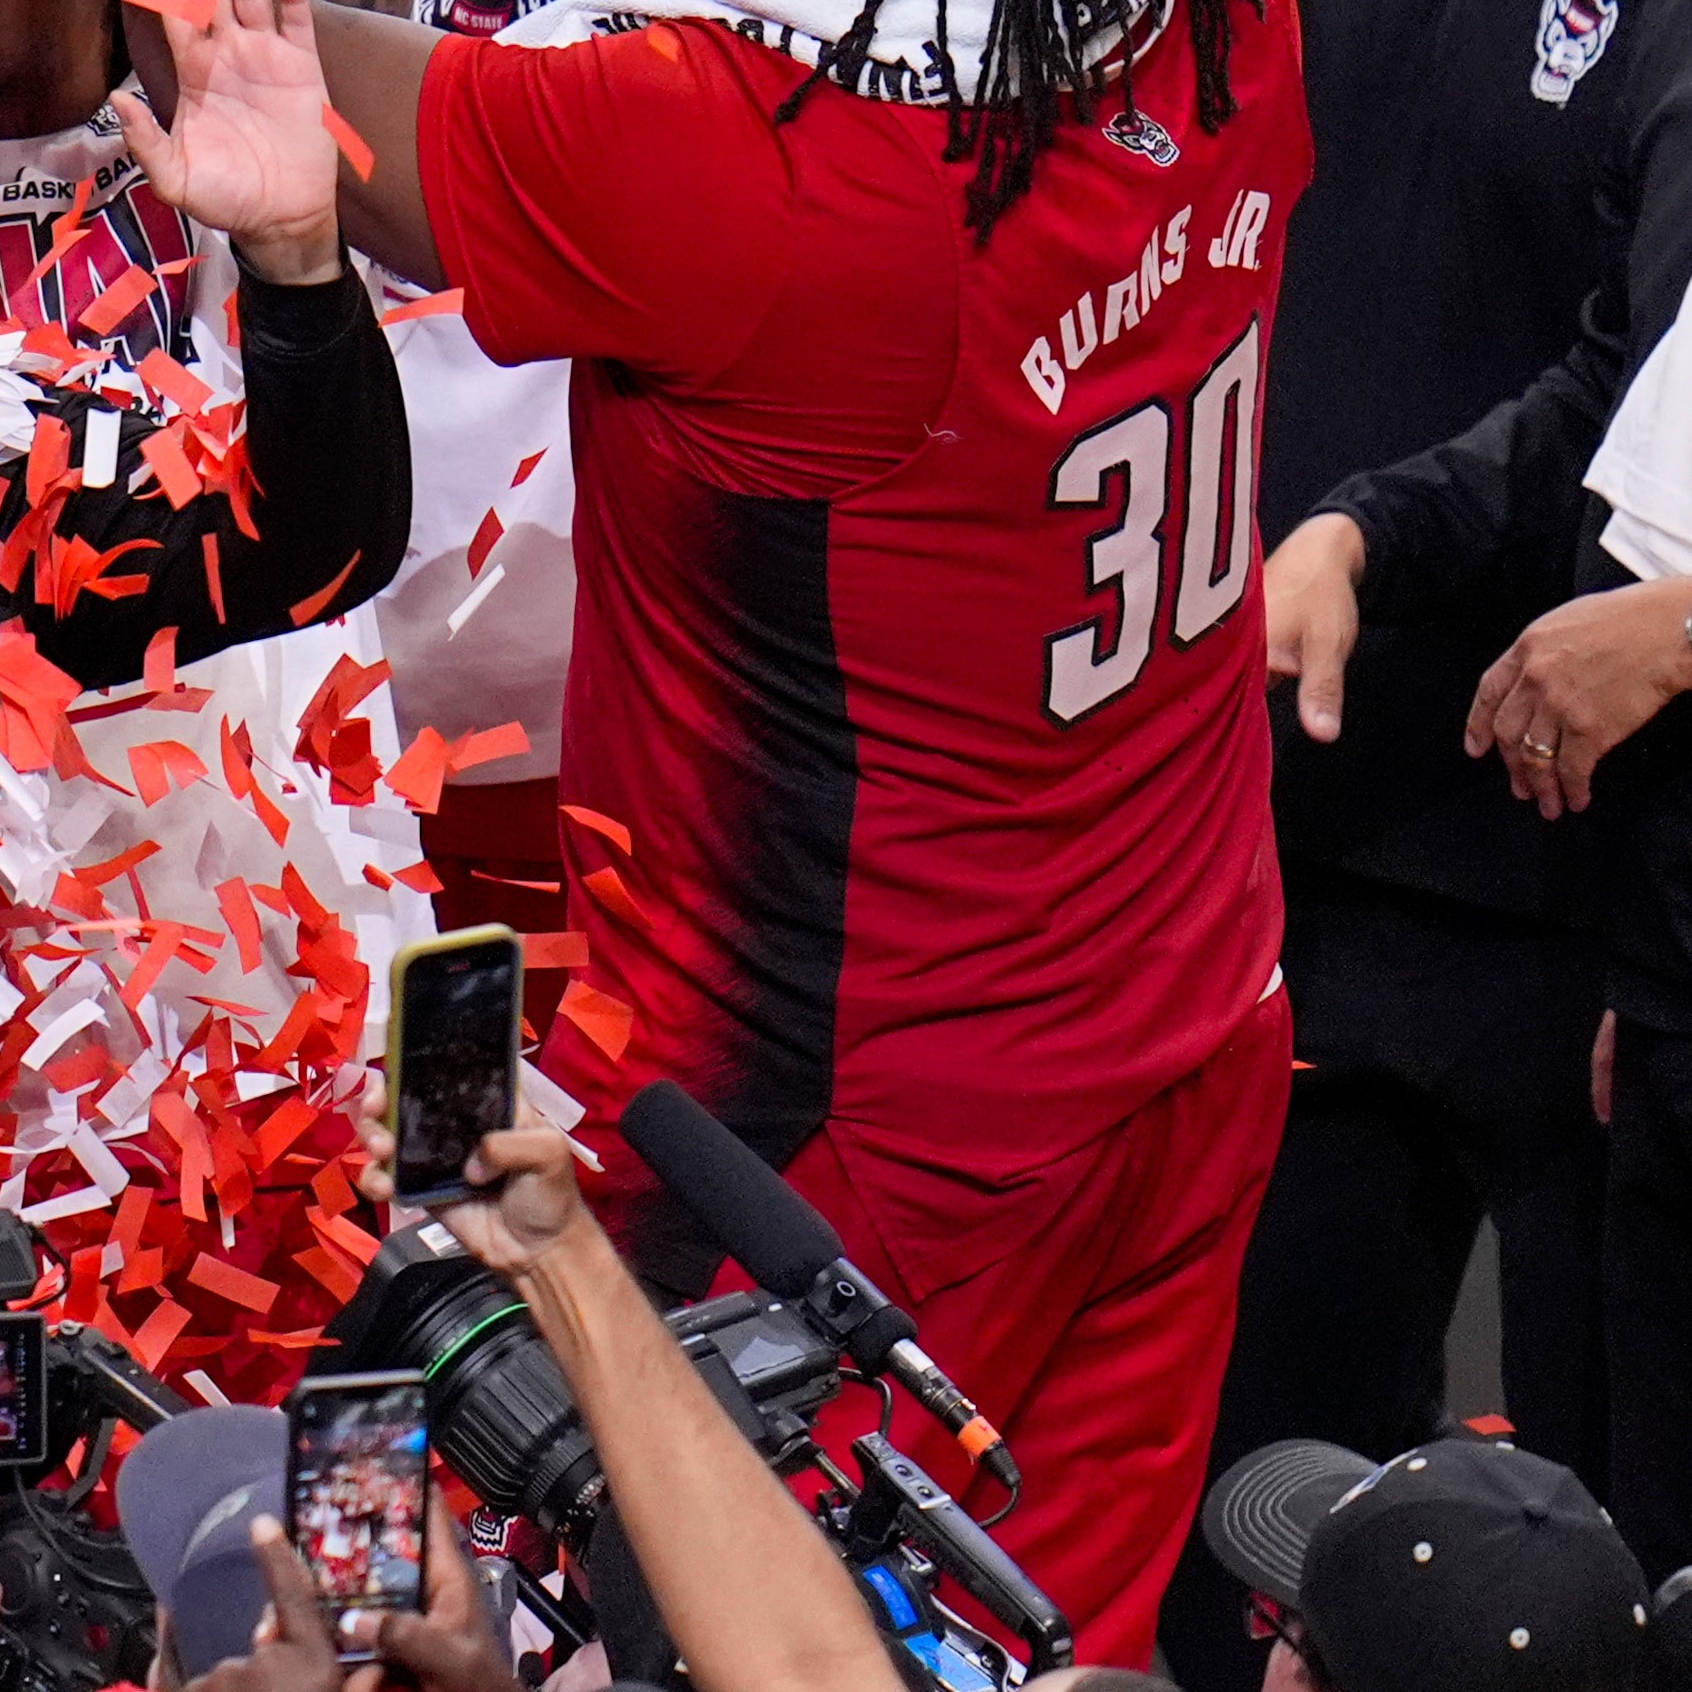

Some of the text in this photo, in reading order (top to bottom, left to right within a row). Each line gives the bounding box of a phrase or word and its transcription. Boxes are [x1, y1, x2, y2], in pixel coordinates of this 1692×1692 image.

[469, 11, 504, 32] STATE
[1020, 203, 1192, 415] BURNS
[1043, 309, 1259, 729] 30
